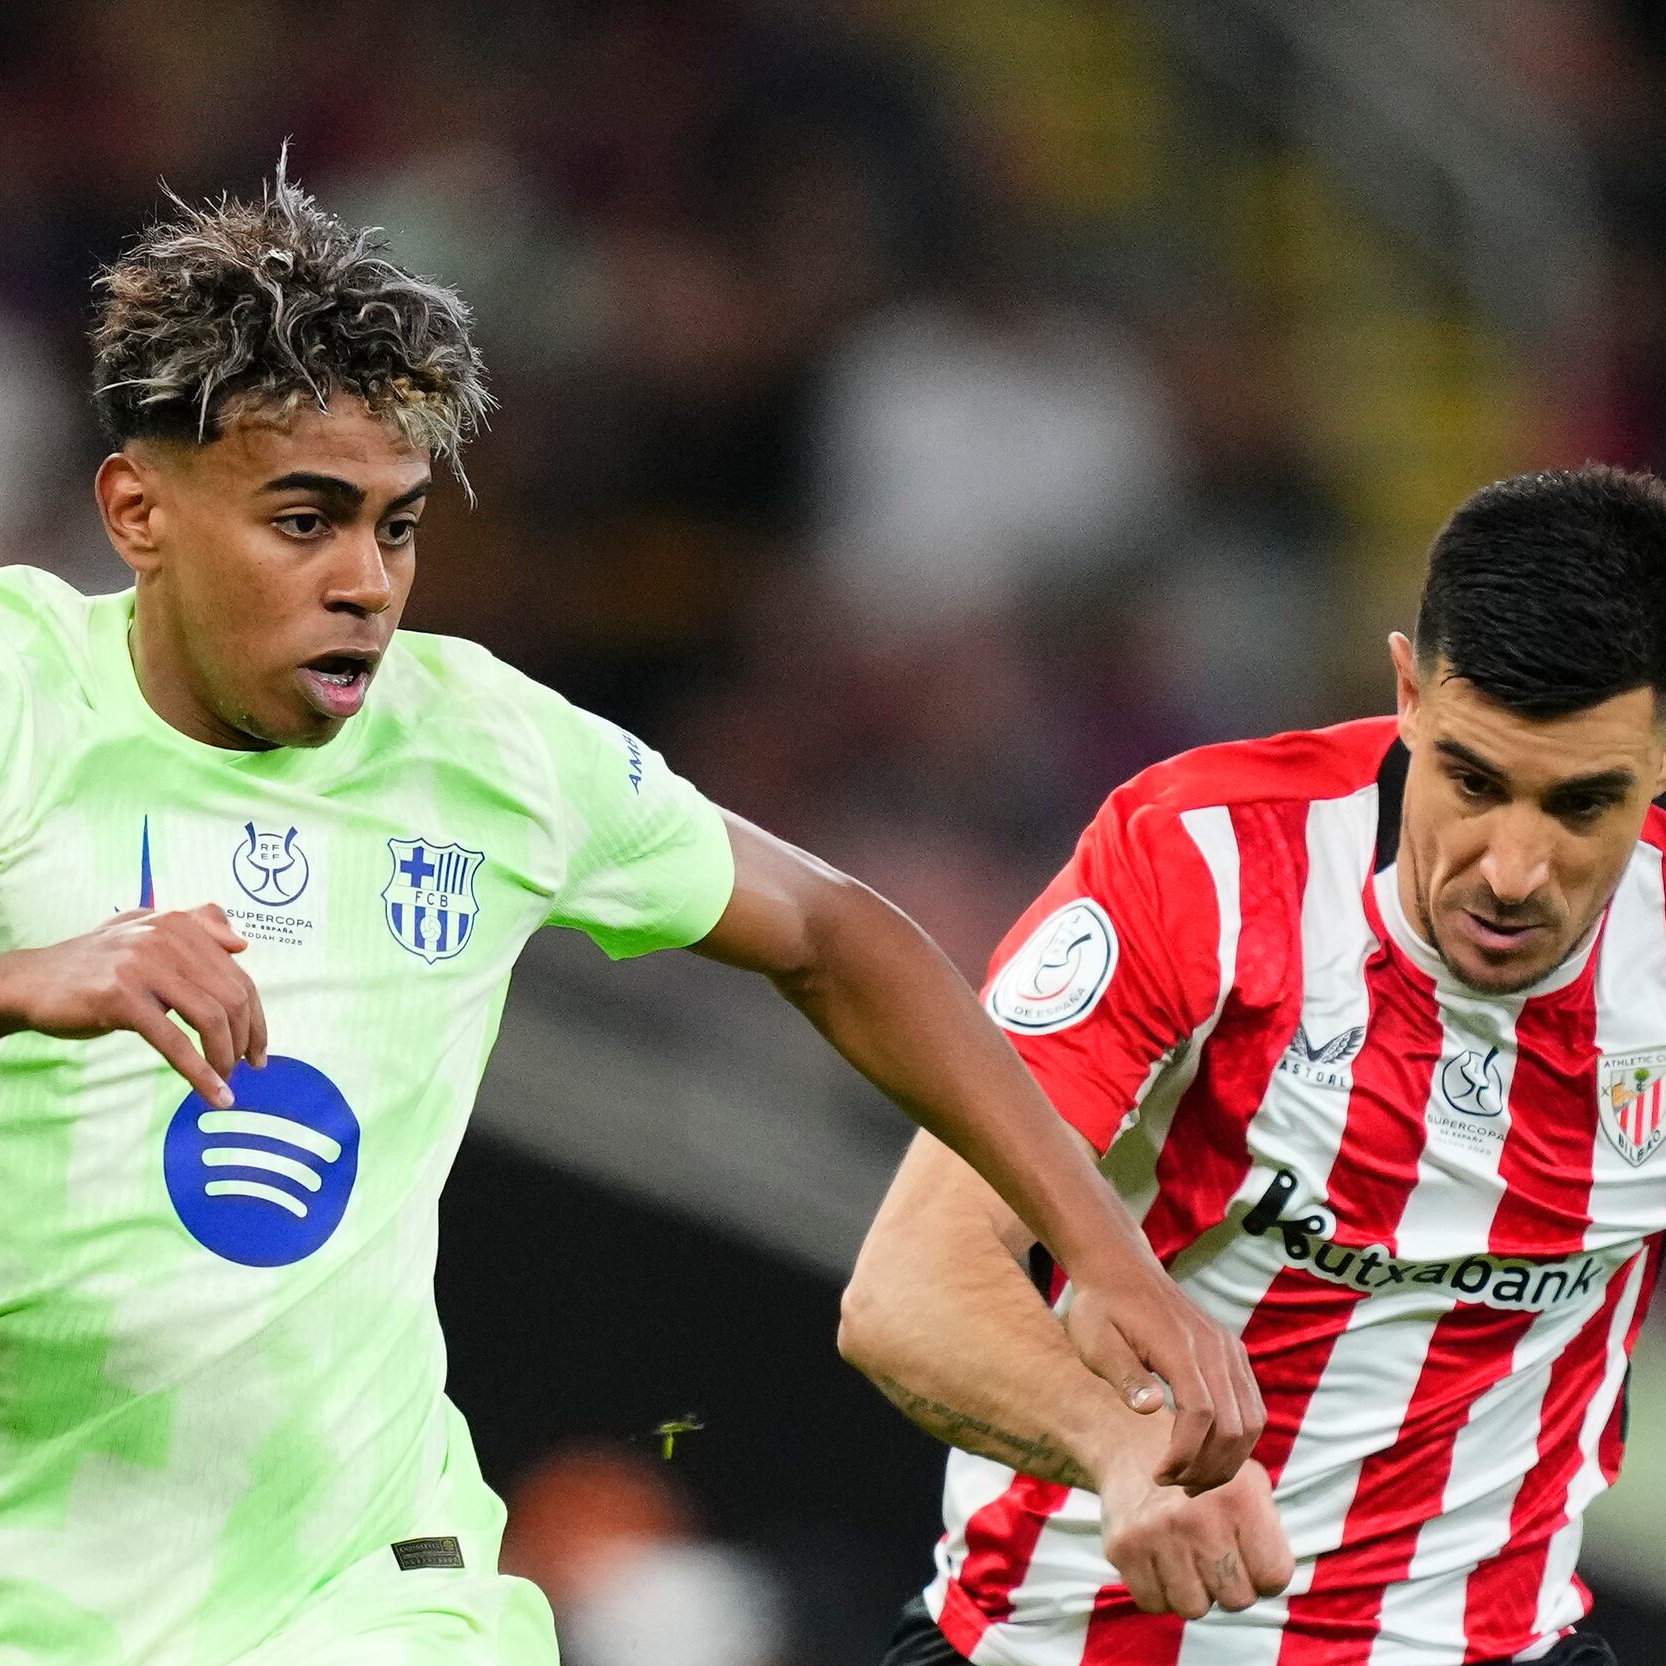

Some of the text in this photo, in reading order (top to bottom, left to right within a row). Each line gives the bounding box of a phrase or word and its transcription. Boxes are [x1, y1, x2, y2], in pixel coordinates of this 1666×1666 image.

[415, 890, 448, 908] FCB
[227, 909, 313, 929] SUPERCOPA
[238, 930, 275, 942] EDDAH
[1604, 1055, 1653, 1069] ATHLETIC
[1427, 1114, 1505, 1142] SUPERCOPA
[1618, 1130, 1661, 1160] BILBAO
